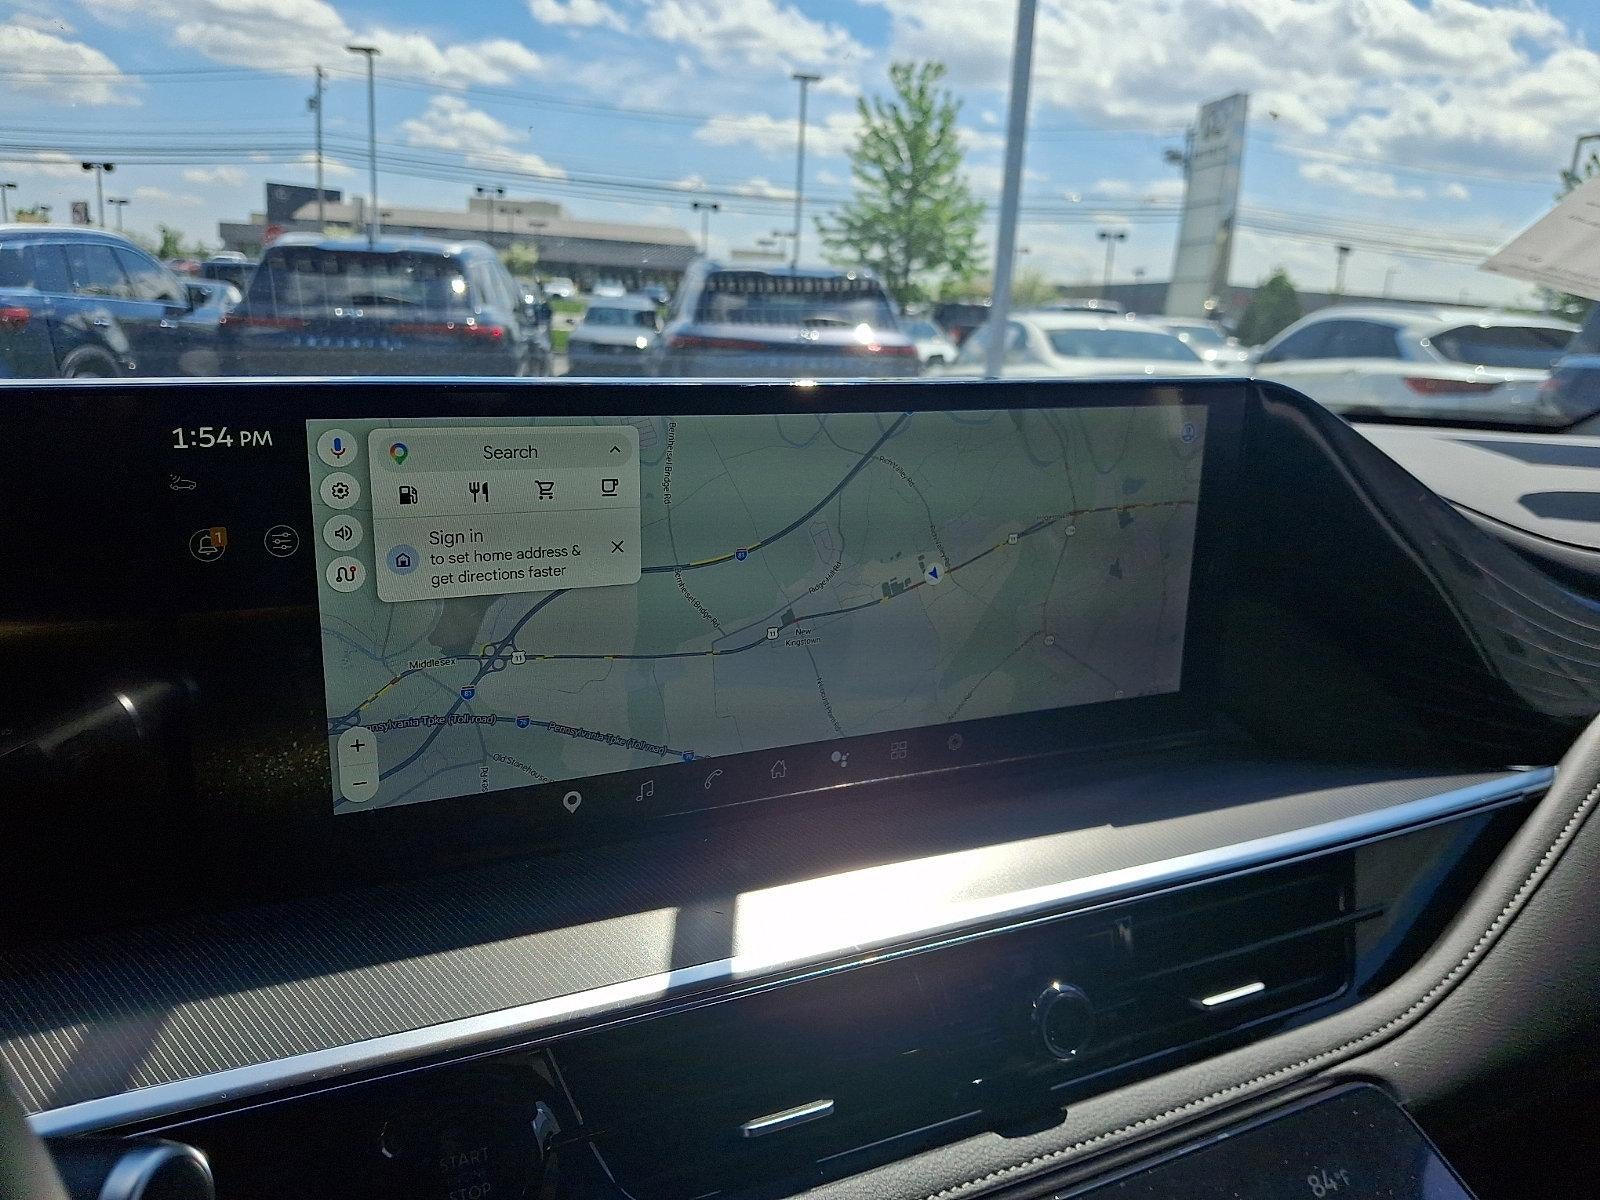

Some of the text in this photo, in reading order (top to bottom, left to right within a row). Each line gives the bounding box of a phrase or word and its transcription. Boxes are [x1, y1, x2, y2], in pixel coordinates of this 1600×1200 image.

[172, 426, 273, 449] 1:54 PM
[483, 444, 538, 460] Search
[662, 466, 673, 492] Bridge
[663, 493, 672, 505] Rd
[428, 528, 484, 548] Sign in
[430, 544, 581, 566] to set home address &
[431, 565, 567, 588] get directions faster
[710, 617, 720, 628] Rd
[795, 628, 812, 636] New
[408, 657, 456, 670] Middlesex
[421, 714, 446, 728] Tpke
[448, 713, 472, 725] (Toll
[471, 713, 498, 726] road)
[549, 721, 606, 742] Pennsylvania
[605, 733, 627, 747] Tpke
[506, 754, 549, 783] Stonehouse
[439, 1146, 489, 1172] START
